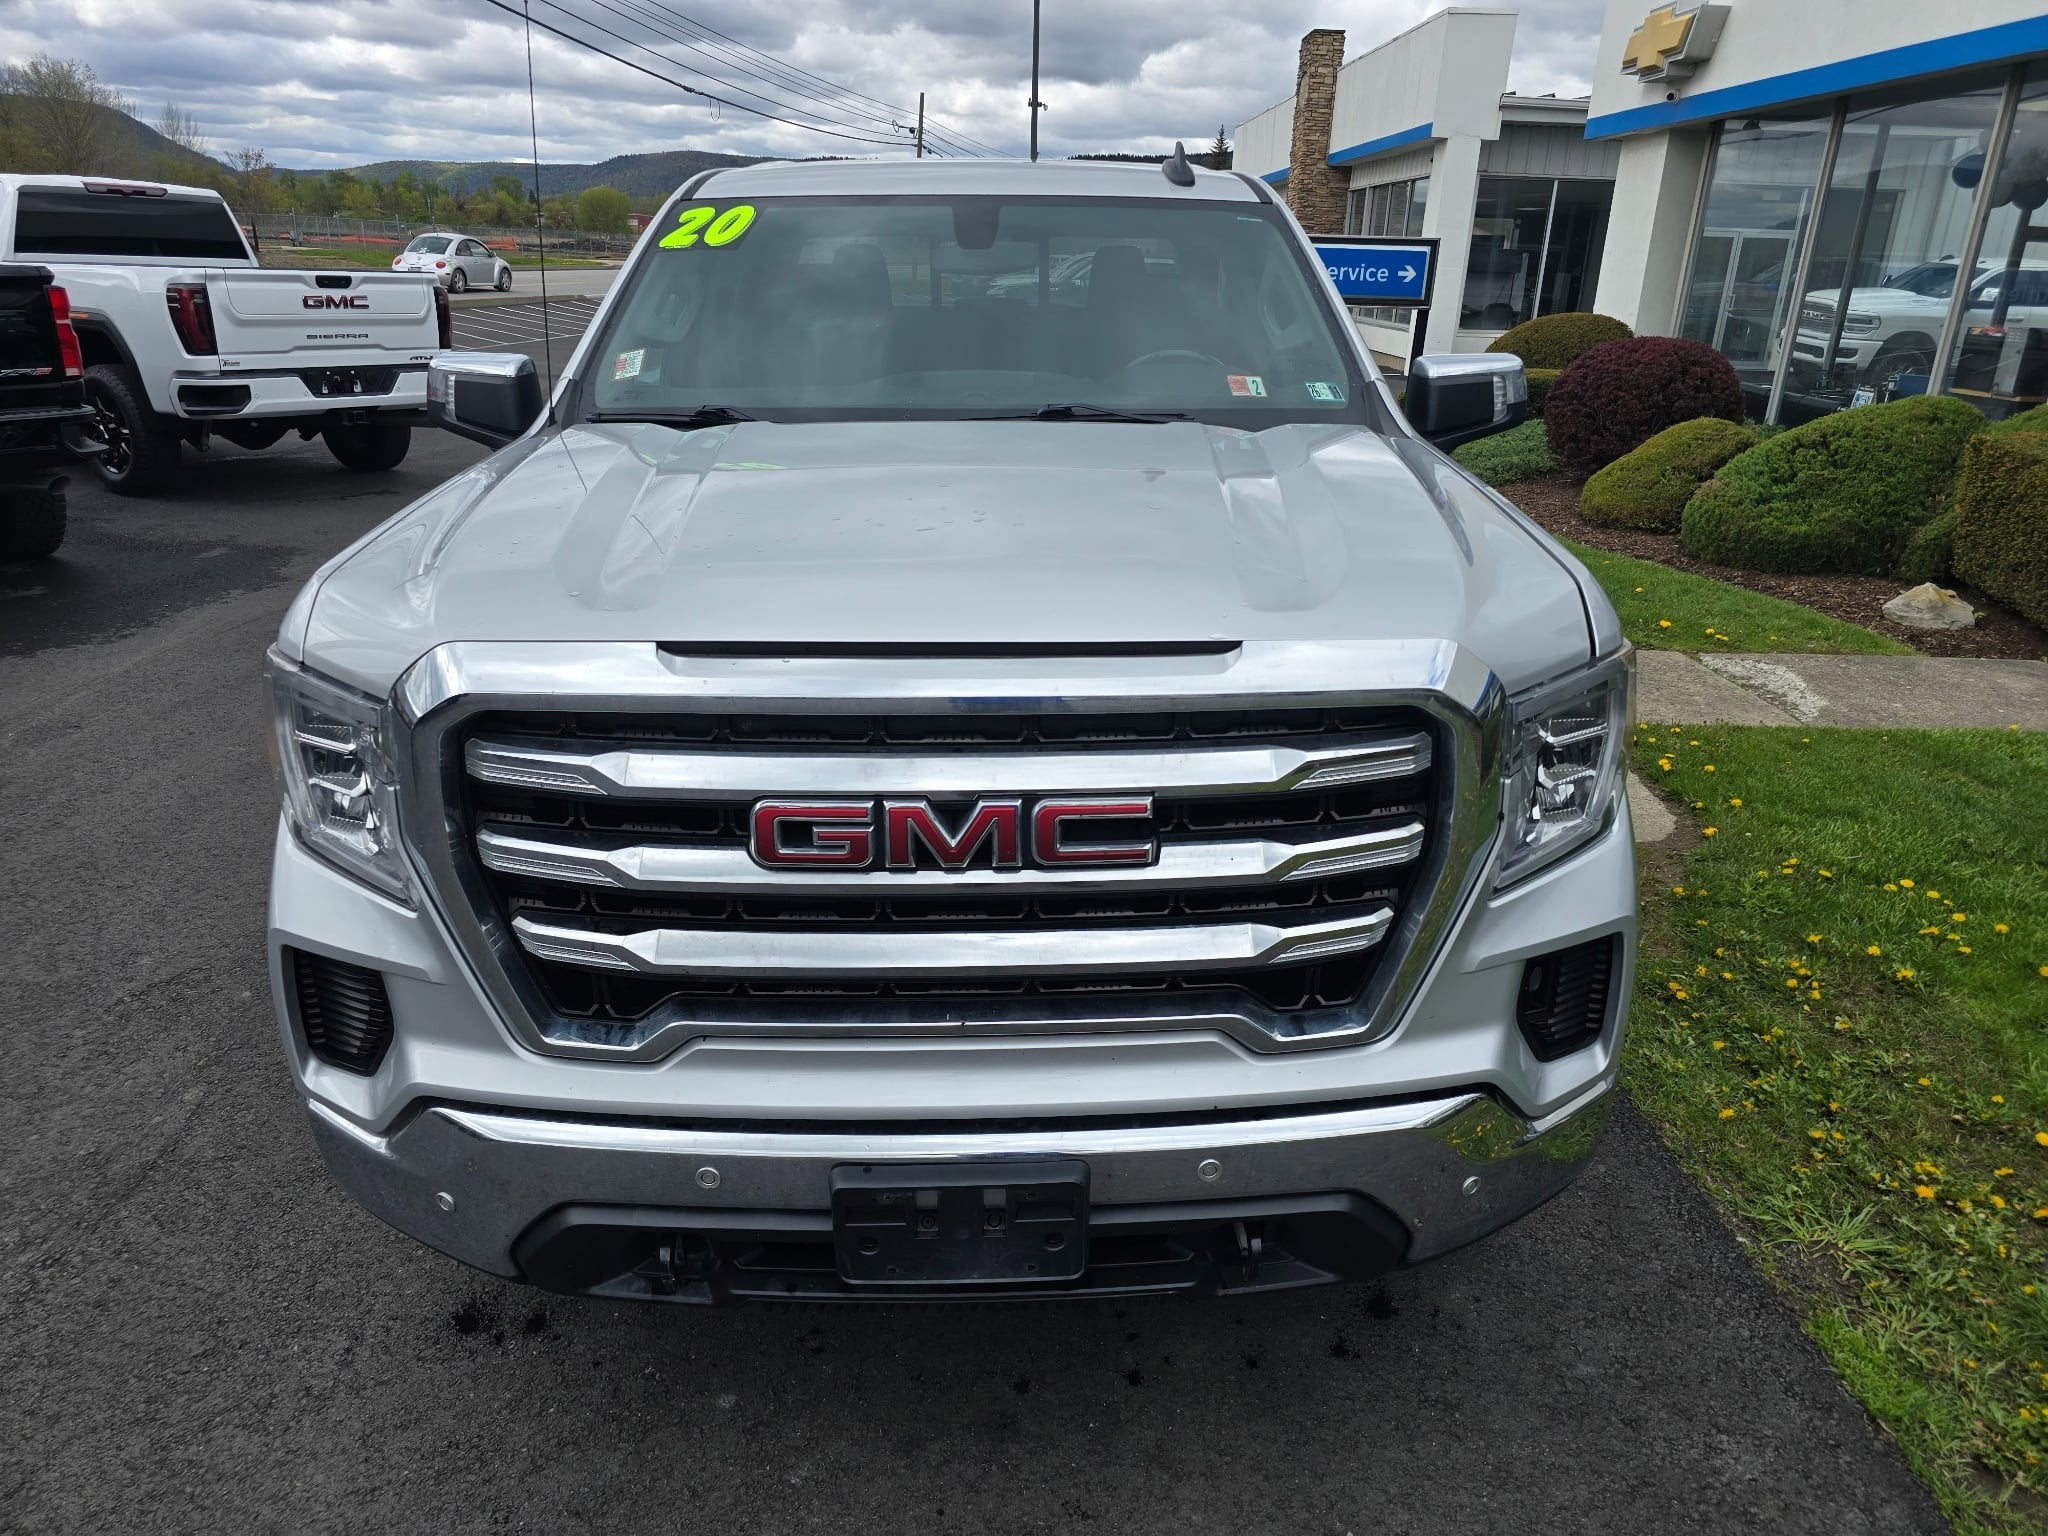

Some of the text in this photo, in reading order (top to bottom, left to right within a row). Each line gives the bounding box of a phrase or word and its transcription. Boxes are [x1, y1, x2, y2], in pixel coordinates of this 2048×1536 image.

[658, 205, 756, 248] 20
[1327, 263, 1389, 282] ervice
[302, 295, 369, 310] GMC
[1251, 379, 1262, 396] 2
[750, 797, 1154, 869] GMC
